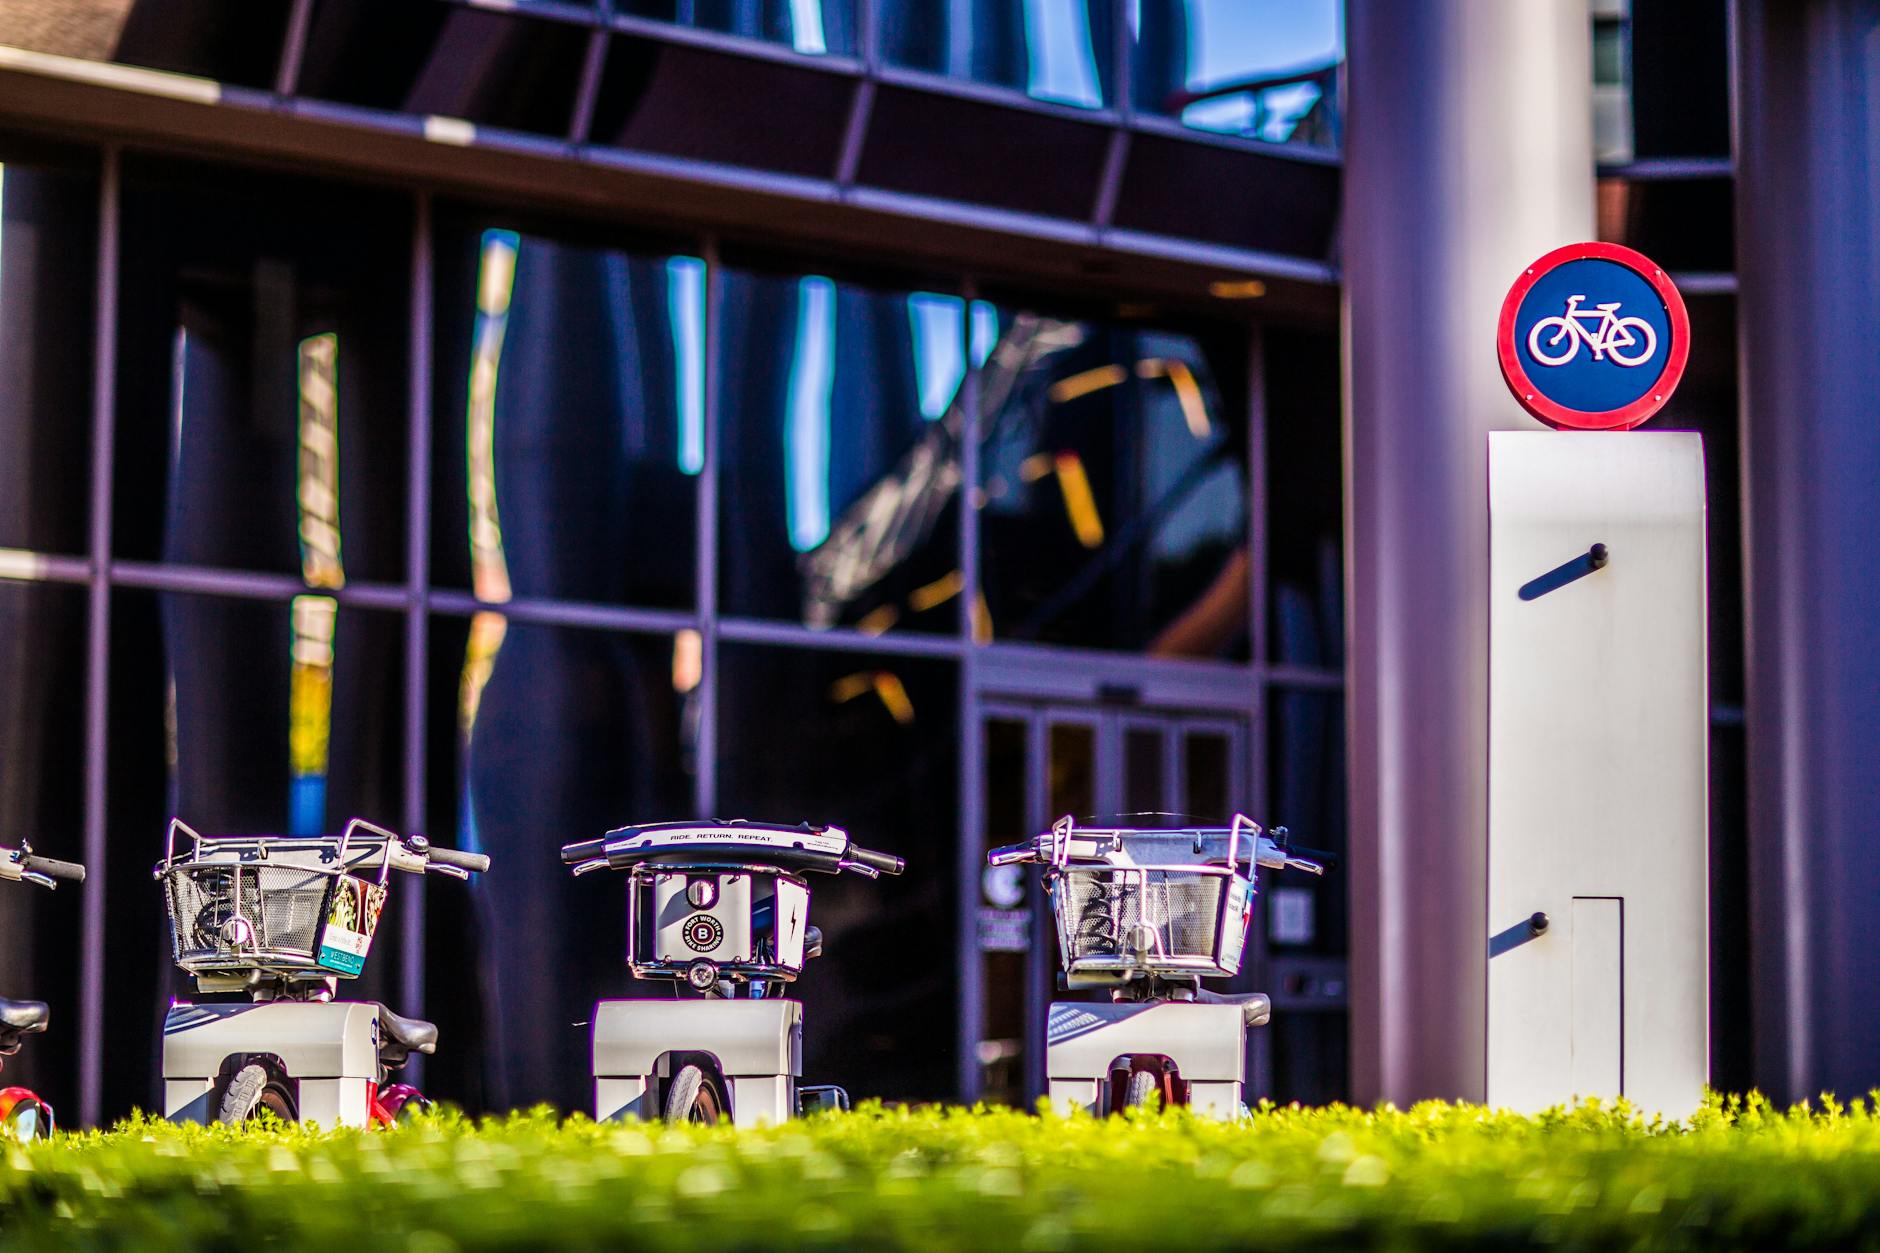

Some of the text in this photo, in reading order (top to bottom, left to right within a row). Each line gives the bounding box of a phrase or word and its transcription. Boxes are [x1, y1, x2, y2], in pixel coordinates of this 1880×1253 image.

[738, 834, 773, 842] REPEAT.
[685, 915, 721, 930] FORT WORTH
[698, 927, 709, 940] B
[684, 935, 722, 951] BIKE SHARING
